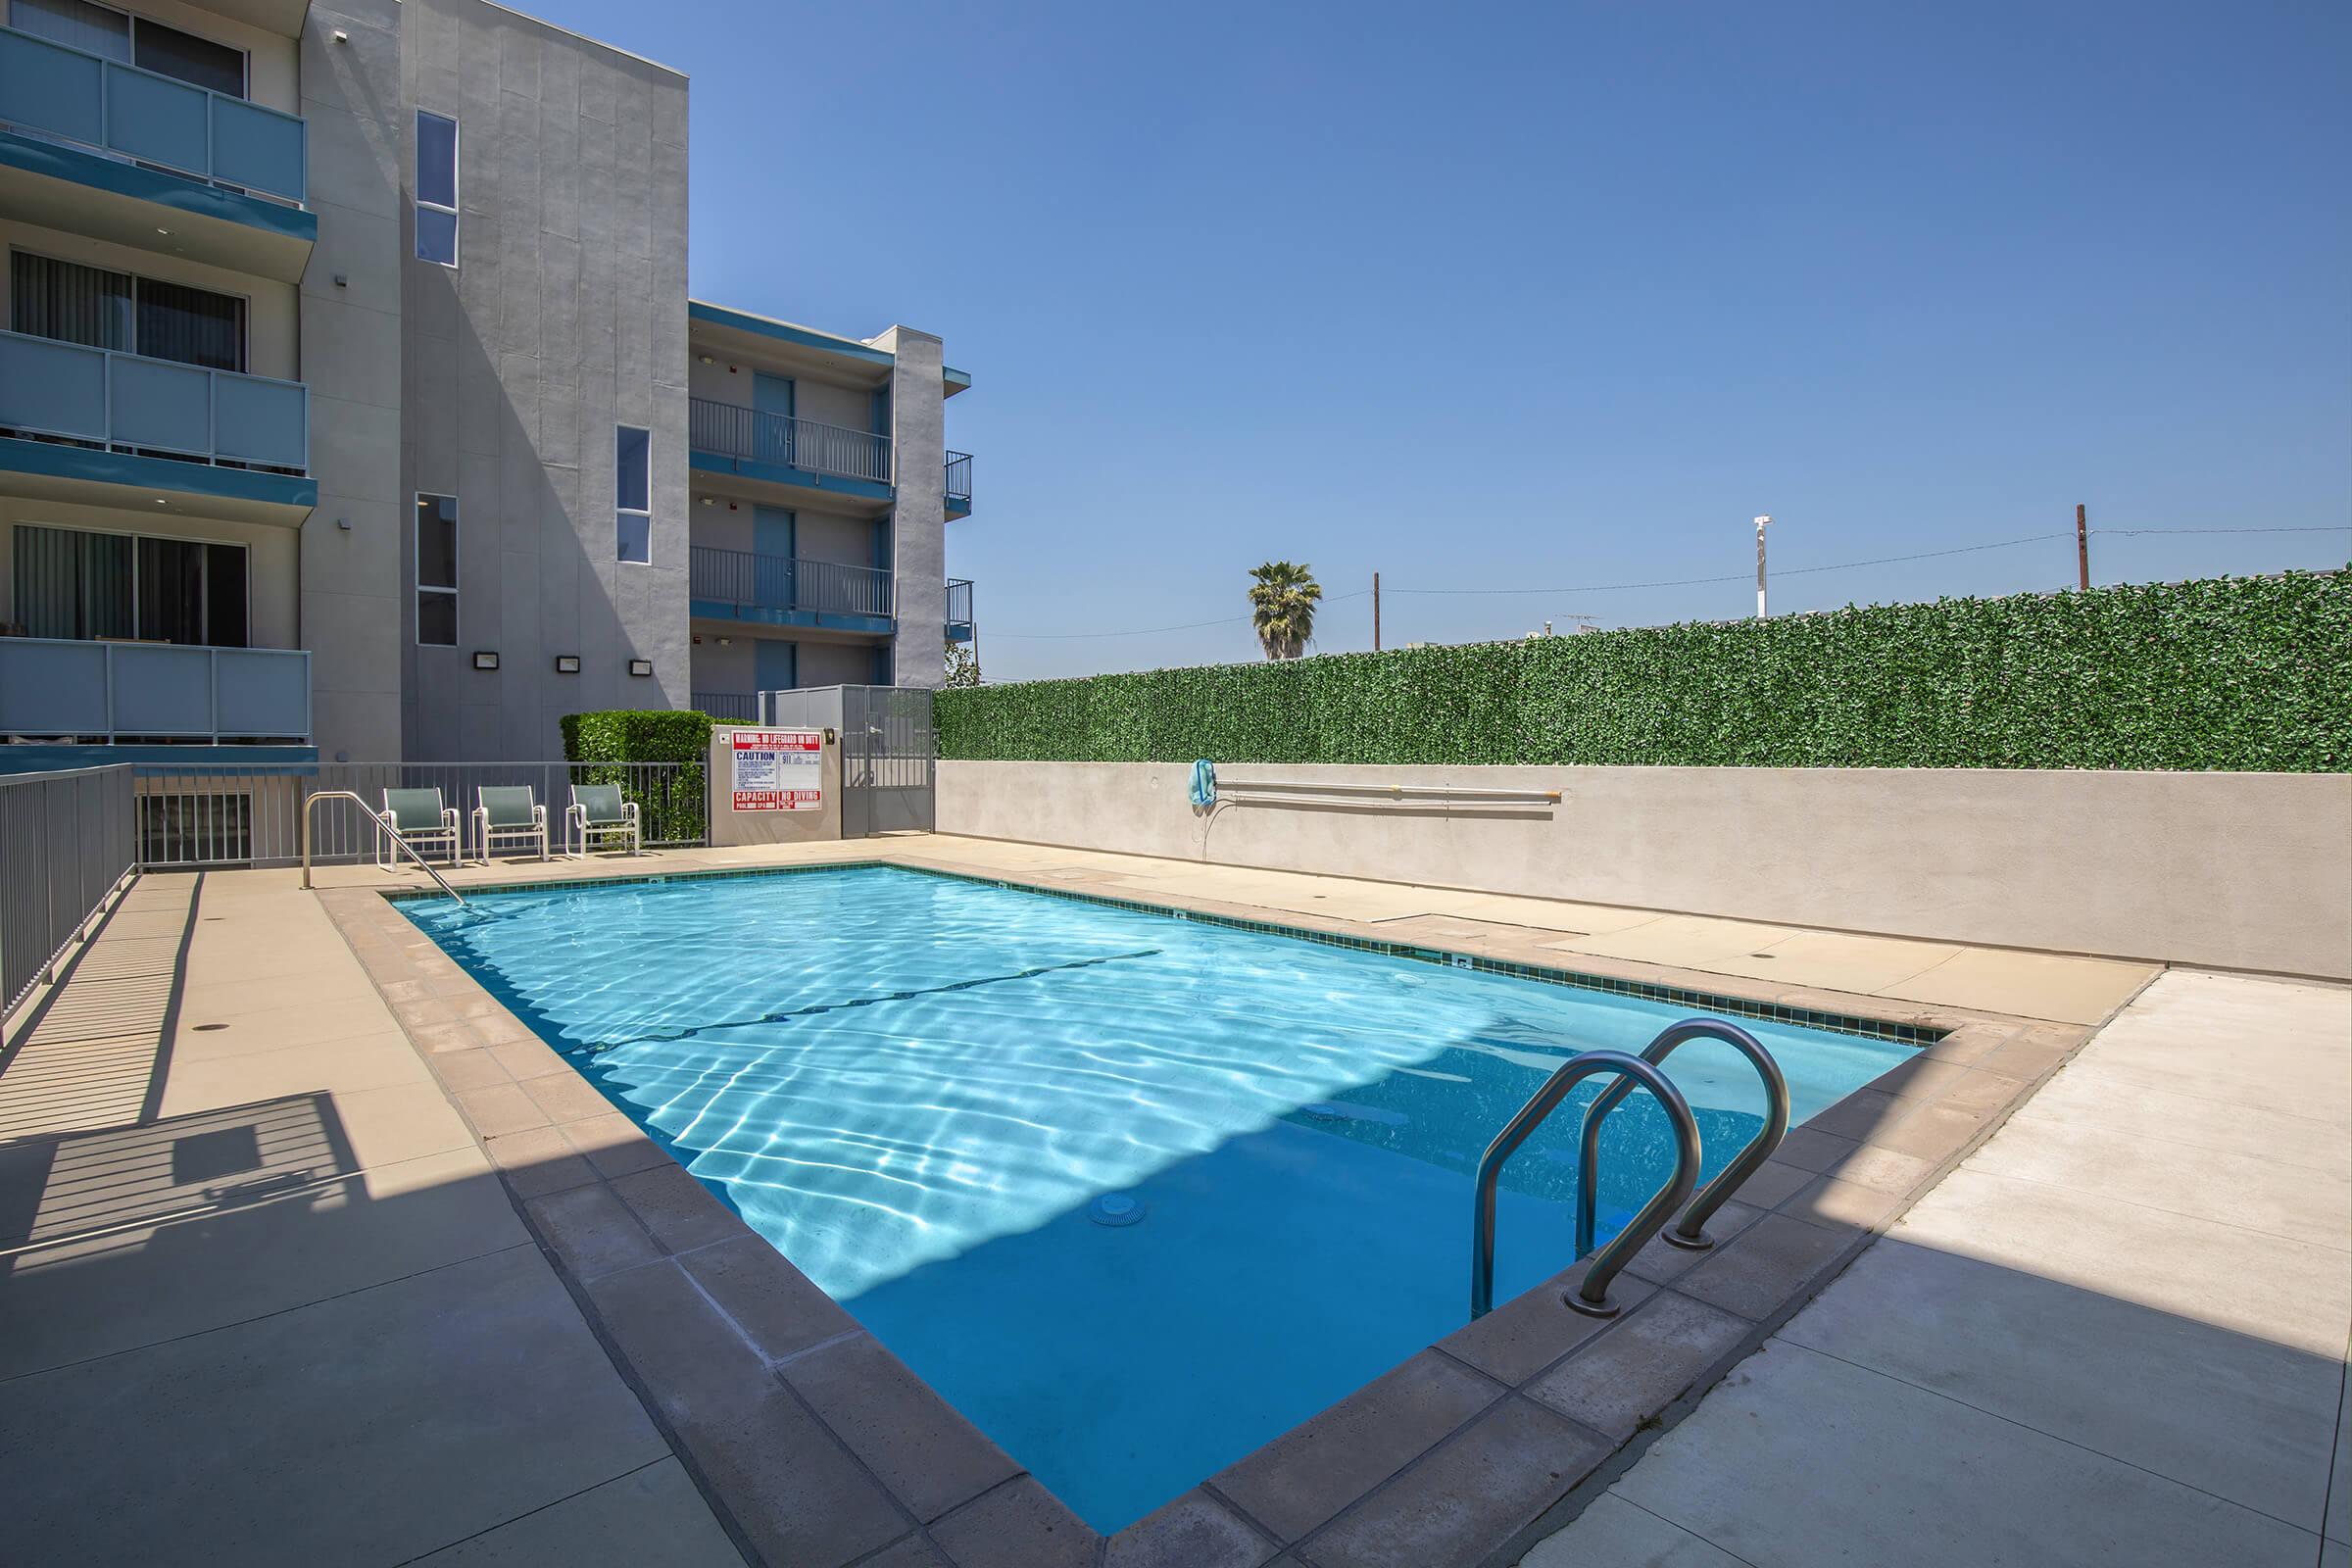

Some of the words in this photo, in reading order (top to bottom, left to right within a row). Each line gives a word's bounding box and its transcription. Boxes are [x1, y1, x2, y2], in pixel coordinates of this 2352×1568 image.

[762, 734, 769, 743] NO
[770, 734, 797, 744] LIFEGUARD
[798, 735, 805, 744] ON
[806, 734, 818, 745] DUTY
[737, 752, 775, 760] CAUTION
[782, 755, 791, 764] 911
[736, 791, 776, 802] CAPACITY
[782, 791, 791, 800] NO
[794, 791, 818, 801] DIVING
